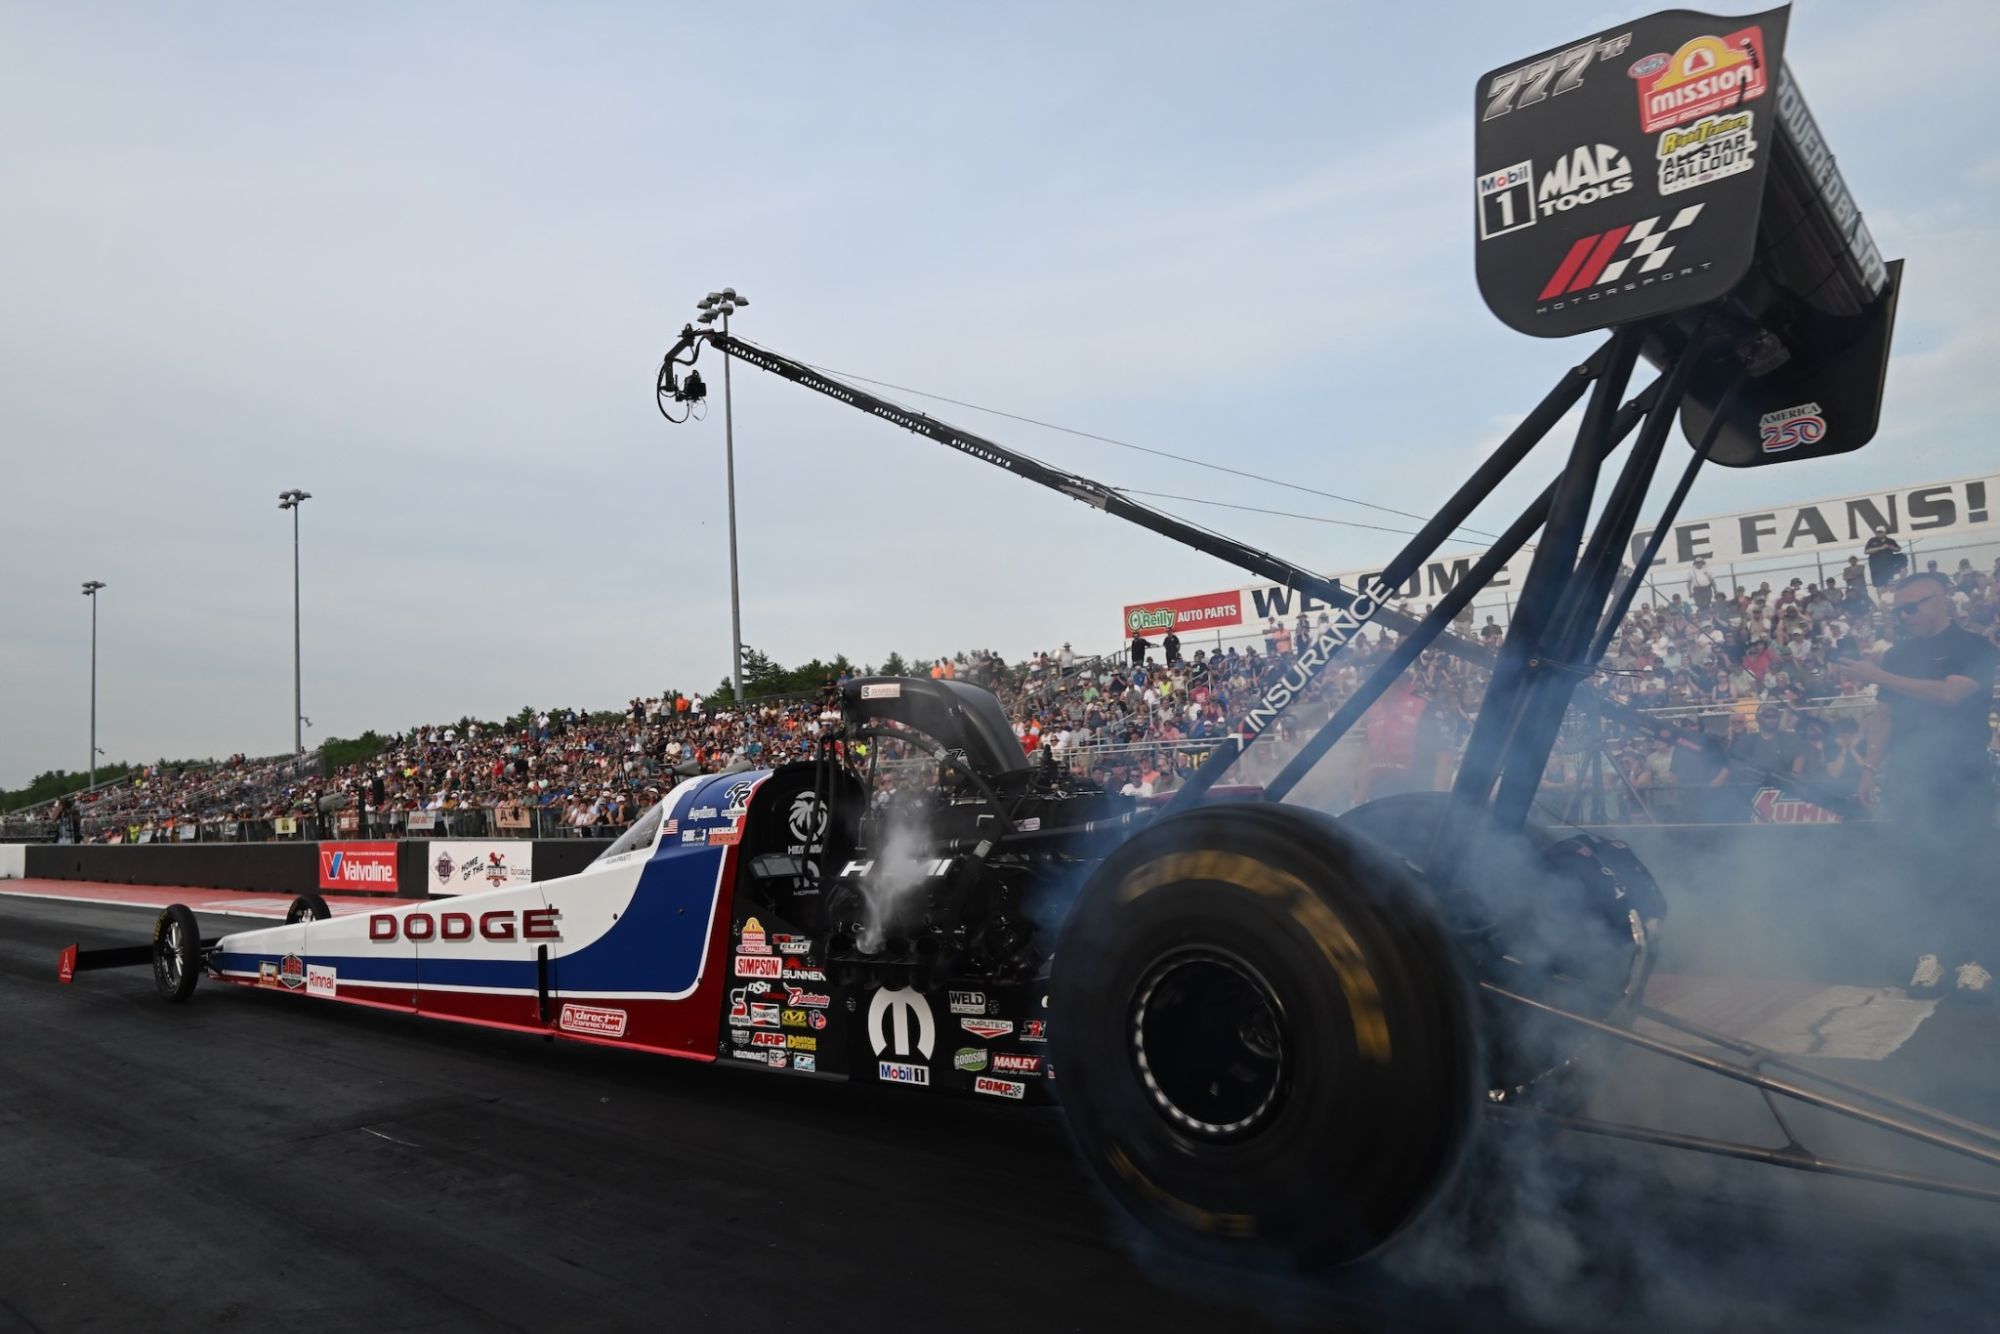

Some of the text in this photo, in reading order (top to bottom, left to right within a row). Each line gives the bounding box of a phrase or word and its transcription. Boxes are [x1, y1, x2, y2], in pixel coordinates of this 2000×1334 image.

[1482, 36, 1602, 122] 777
[1539, 143, 1633, 203] MAC
[1663, 147, 1748, 186] CALLOUT
[1481, 164, 1528, 193] Mobil
[1538, 176, 1634, 217] TOOLS
[1496, 190, 1515, 227] 1
[1849, 221, 1888, 297] SRT
[1536, 261, 1713, 315] MOTORSPORT
[1761, 404, 1819, 426] AMERICA
[1738, 480, 1989, 555] FANS!
[1128, 603, 1237, 631] O'Reilly AUTO PARTS
[1245, 582, 1395, 733] INSURANCE
[342, 860, 393, 882] Valvoline
[461, 856, 479, 872] HOME
[463, 870, 471, 881] OF
[472, 862, 485, 876] THE
[368, 908, 563, 943] DODGE
[737, 958, 780, 976] SIMPSON
[309, 971, 334, 990] Rinnai
[951, 992, 985, 1005] WELD
[961, 1019, 1012, 1029] COMPUTECH
[754, 1033, 786, 1045] ARP
[954, 1050, 987, 1066] GOODSON
[994, 1056, 1038, 1070] MANLEY
[881, 1064, 913, 1081] Mobil
[977, 1079, 1012, 1092] COMP
